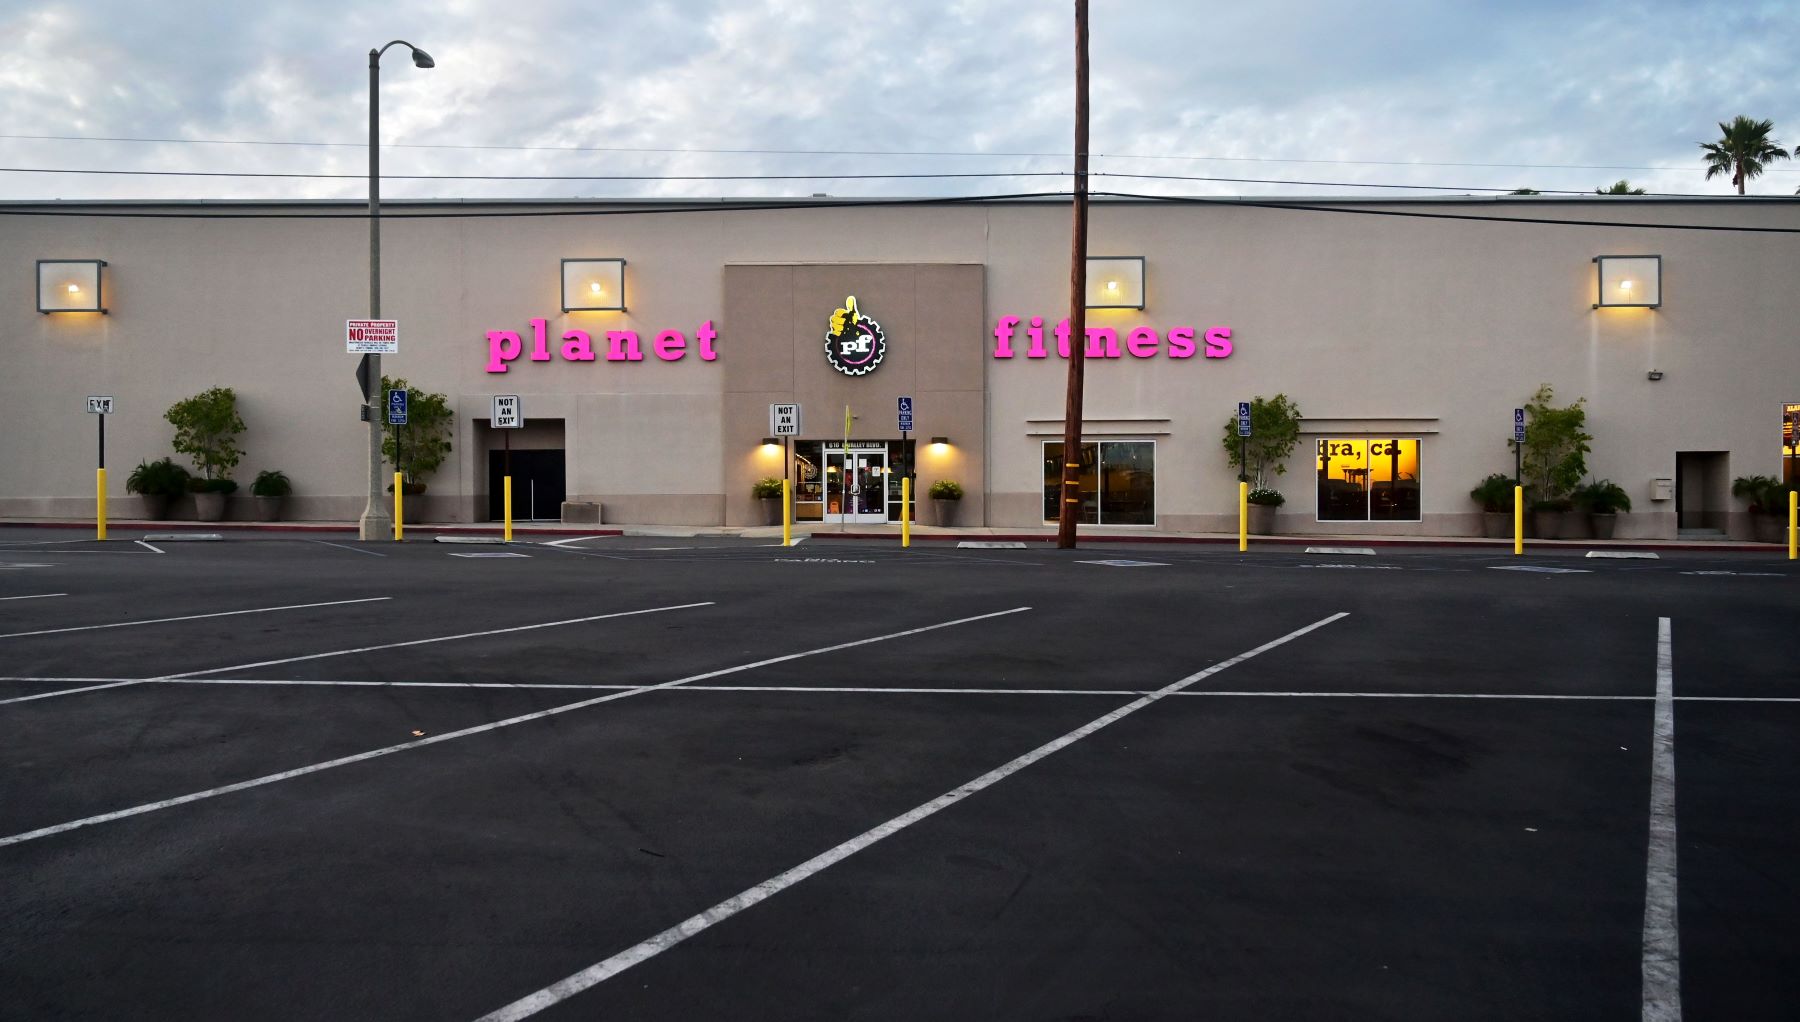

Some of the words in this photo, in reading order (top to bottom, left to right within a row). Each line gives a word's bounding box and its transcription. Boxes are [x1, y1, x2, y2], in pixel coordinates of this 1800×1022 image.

[349, 328, 363, 341] NO
[485, 318, 717, 372] planet
[994, 315, 1233, 358] fitness
[840, 334, 873, 355] pf
[498, 398, 513, 406] NOT
[501, 407, 511, 415] AN
[778, 406, 793, 414] NOT
[498, 417, 514, 425] EXIT
[778, 425, 794, 433] EXIT
